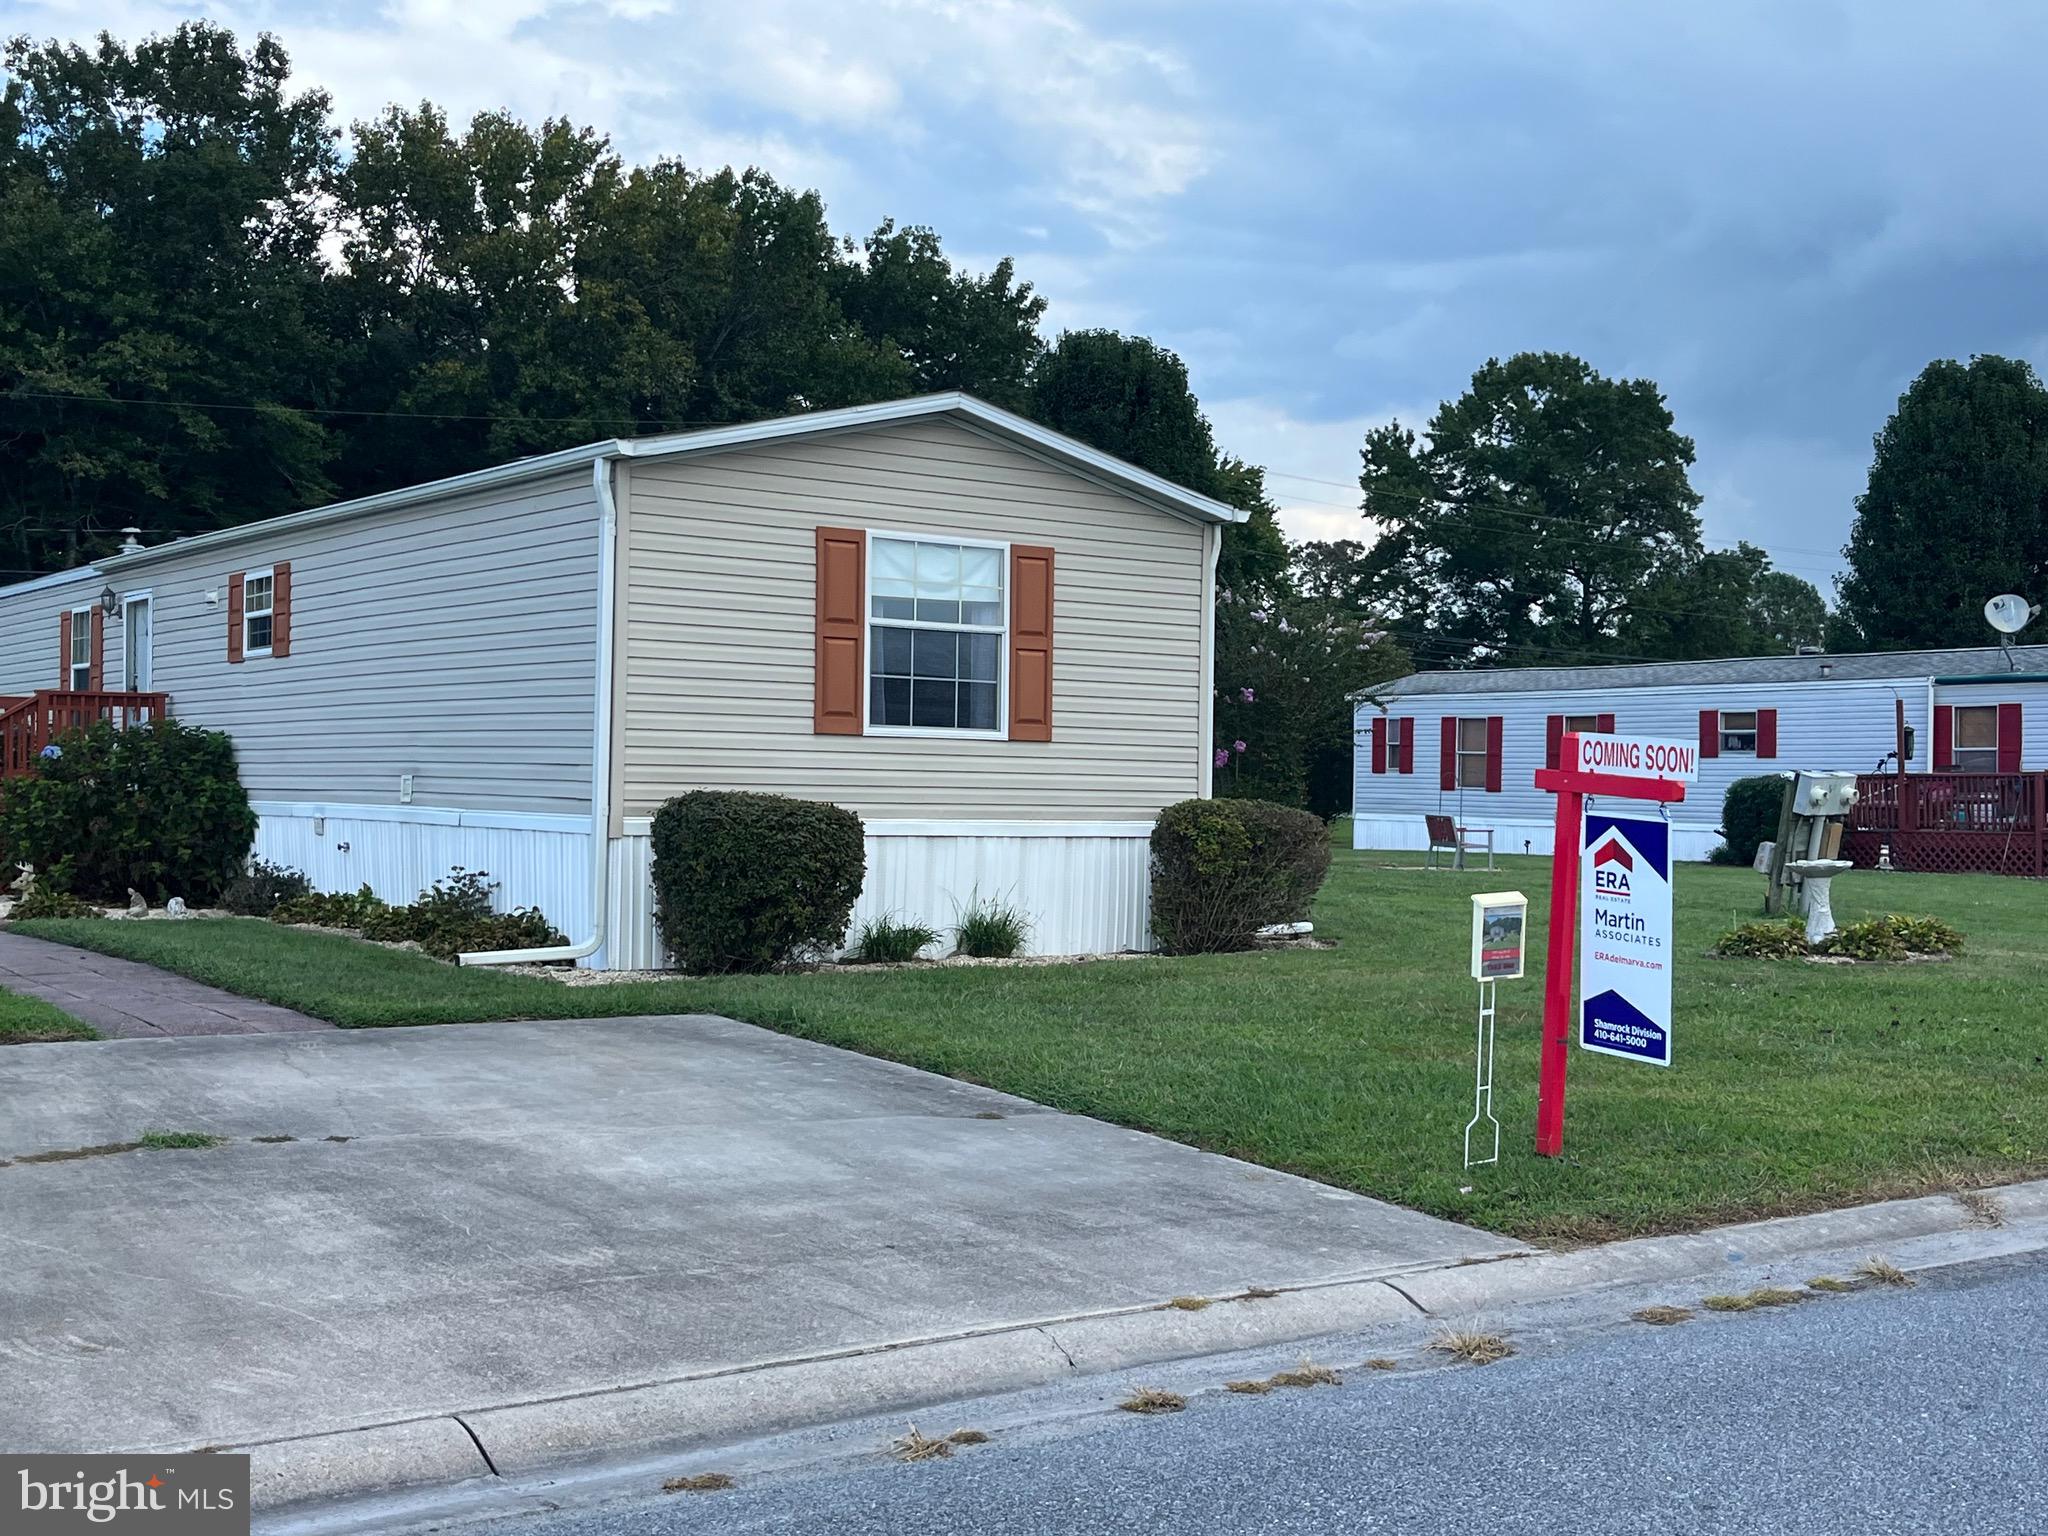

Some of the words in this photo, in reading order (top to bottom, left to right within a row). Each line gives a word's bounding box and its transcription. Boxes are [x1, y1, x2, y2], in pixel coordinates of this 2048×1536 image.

[1583, 740, 1640, 768] COMING
[1645, 744, 1694, 773] SOON!
[1595, 870, 1630, 891] ERA
[1610, 896, 1631, 904] ESTATE
[1595, 908, 1645, 931] Martin
[1595, 929, 1661, 947] ASSOCIATES
[1594, 951, 1663, 970] ERAdelmarva.com
[1594, 1018, 1630, 1034] Shamrock
[1631, 1026, 1662, 1041] Division
[1594, 1029, 1647, 1048] 410-641-5000
